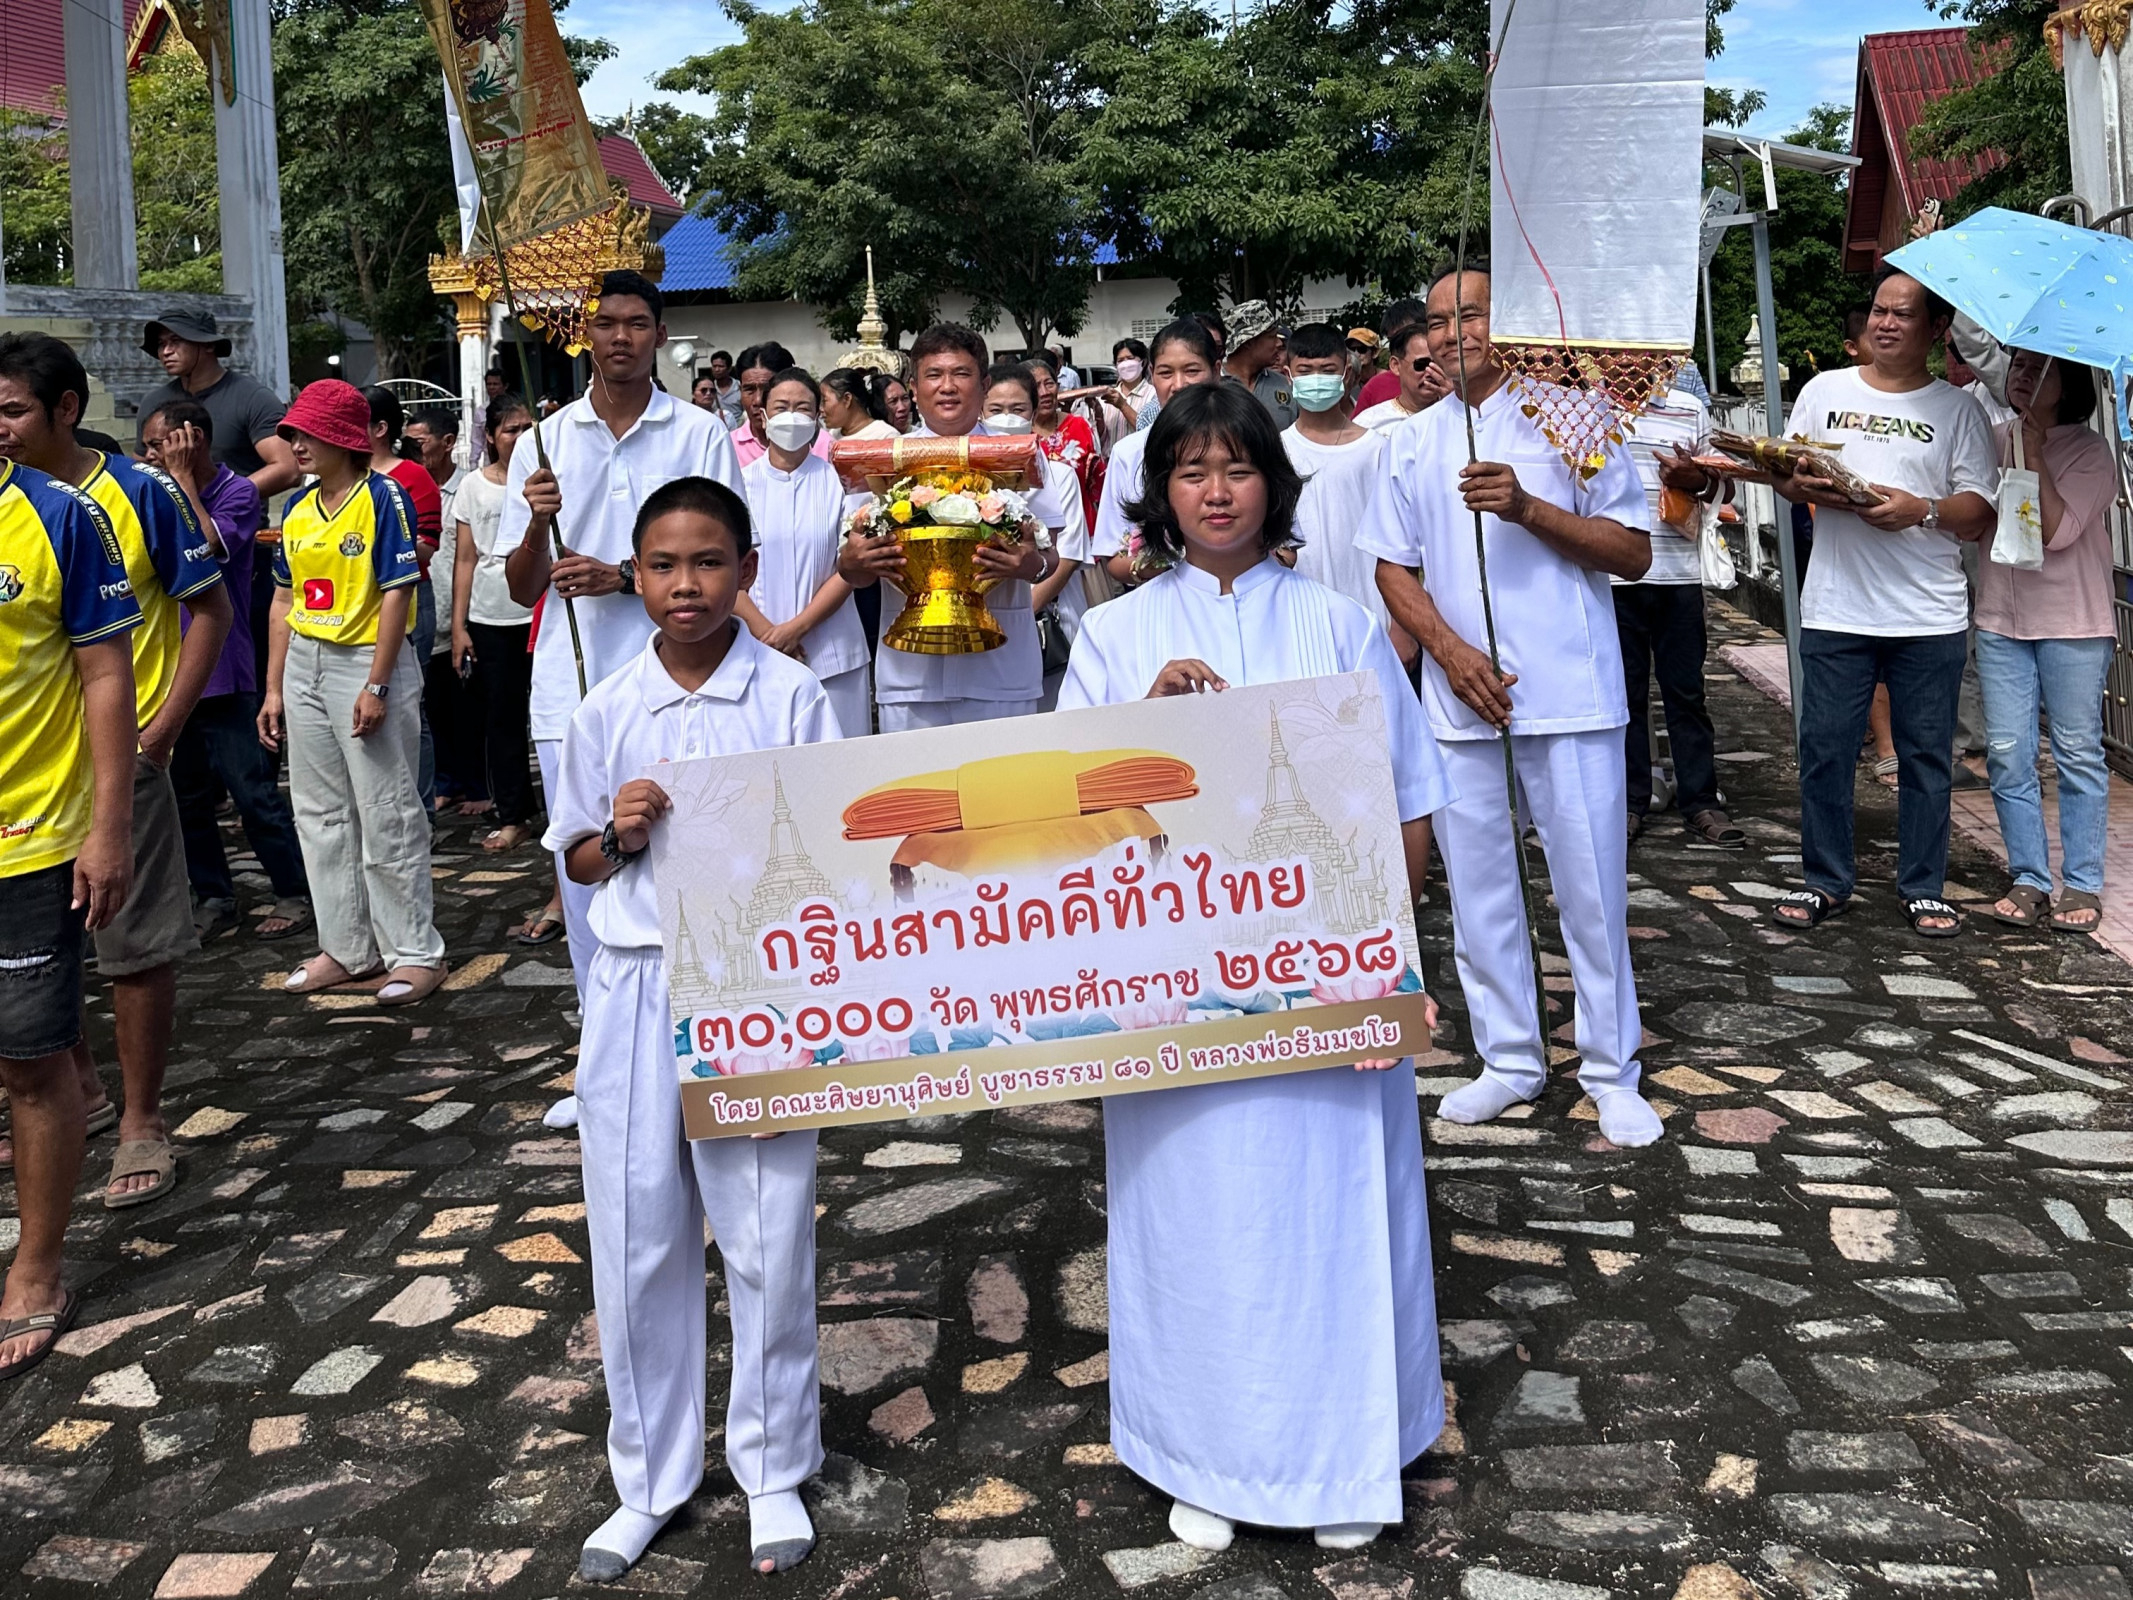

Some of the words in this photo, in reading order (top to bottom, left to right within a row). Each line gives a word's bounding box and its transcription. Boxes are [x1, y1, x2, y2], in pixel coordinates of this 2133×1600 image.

[763, 846, 1306, 987] กฐินสามัคคีทั่วไทย
[697, 996, 913, 1053] ๓๐,๐๐๐
[930, 985, 979, 1026] วัด
[990, 968, 1200, 1034] พุทธศักราช
[1215, 928, 1397, 991] ๒๕๖๘
[712, 1096, 761, 1121] โดย
[772, 1067, 971, 1114] คณะศิษยานุศิษย์
[981, 1062, 1103, 1100] บูชาธรรม
[1114, 1058, 1151, 1078] ๘๑
[1160, 1046, 1180, 1071] ปี
[1190, 1017, 1399, 1069] หลวงพ่อธัมมชโย
